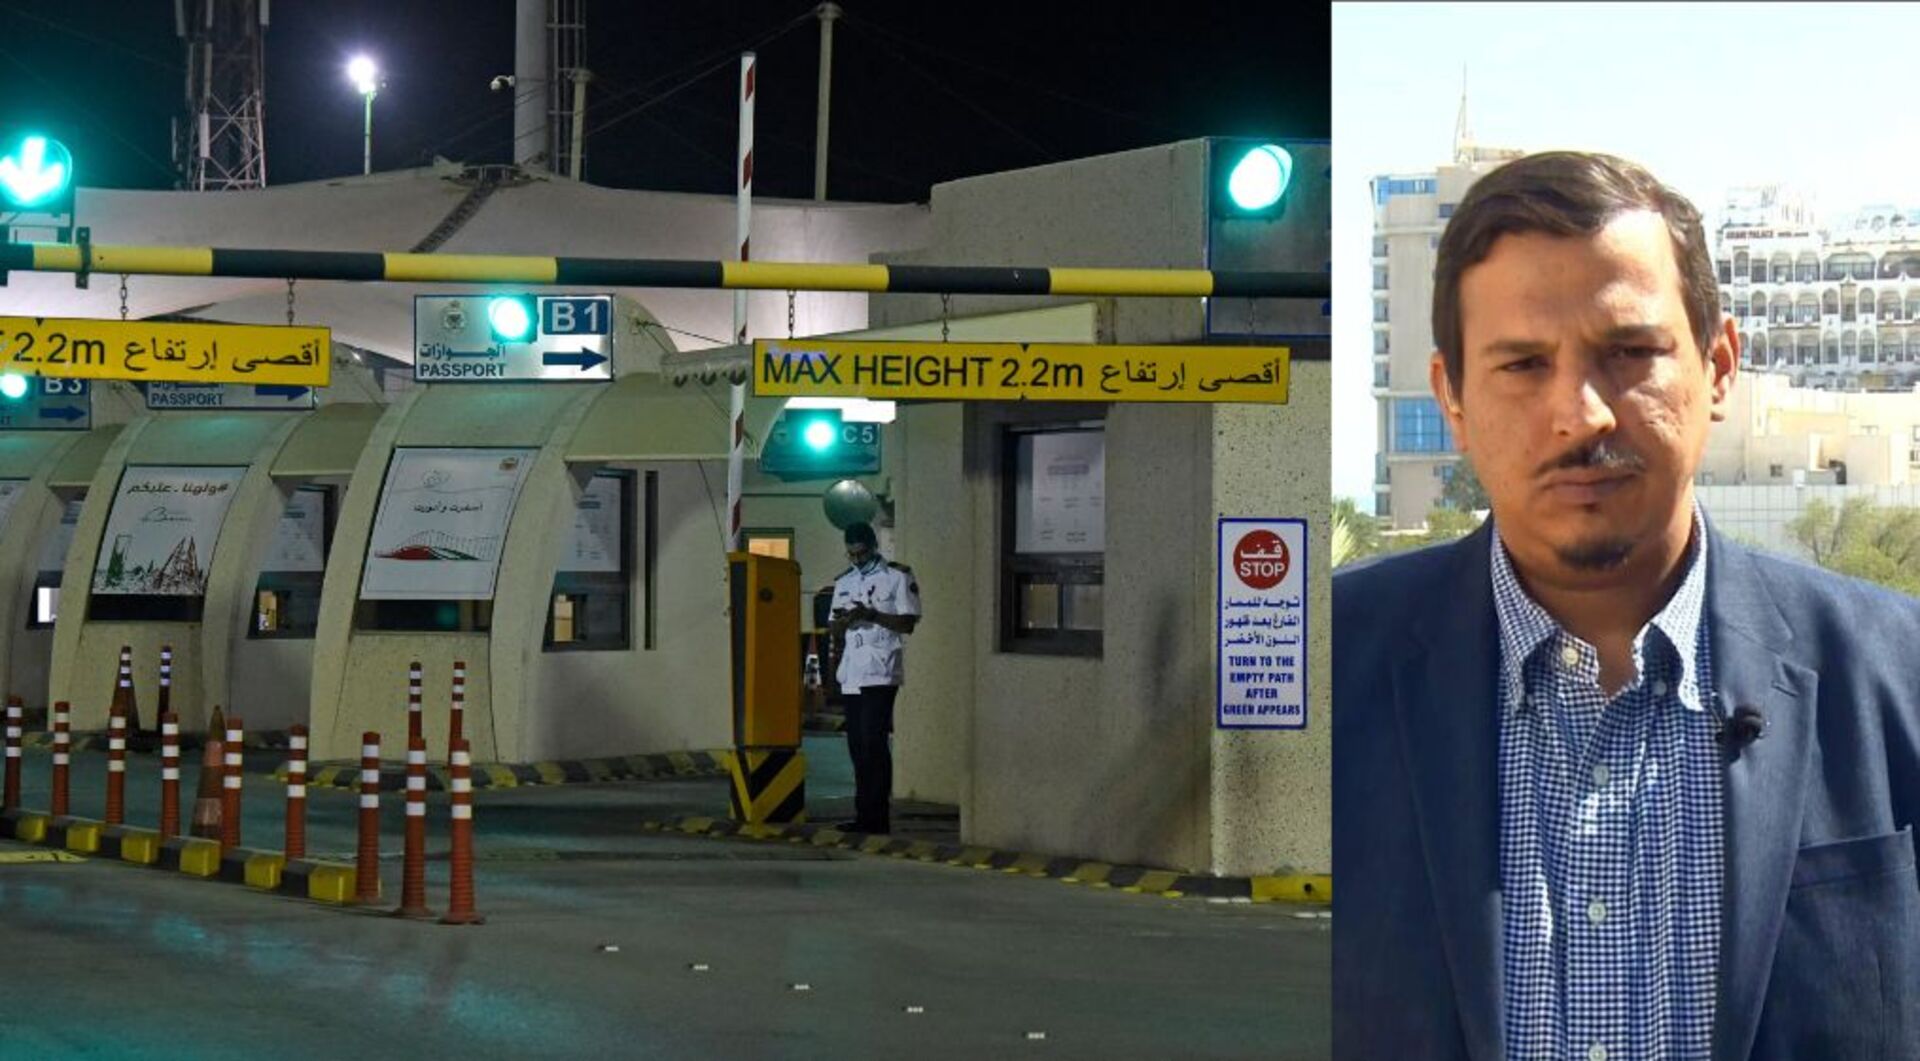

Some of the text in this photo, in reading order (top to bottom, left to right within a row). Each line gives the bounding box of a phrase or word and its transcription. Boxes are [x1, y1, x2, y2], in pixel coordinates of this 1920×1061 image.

[12, 331, 105, 365] 2.2m
[232, 339, 320, 373] أقصى
[419, 363, 508, 378] PASSPORT
[763, 352, 1084, 389] MAX HEIGHT 2.2m
[1198, 358, 1281, 392] أقصى
[150, 392, 224, 405] PASSPORT
[1240, 561, 1286, 578] STOP
[1228, 656, 1295, 667] TURN TO THE
[1229, 673, 1295, 683] EMPTY PATH
[1245, 688, 1278, 699] AFTER
[1223, 705, 1301, 715] GREEN APPEARS
